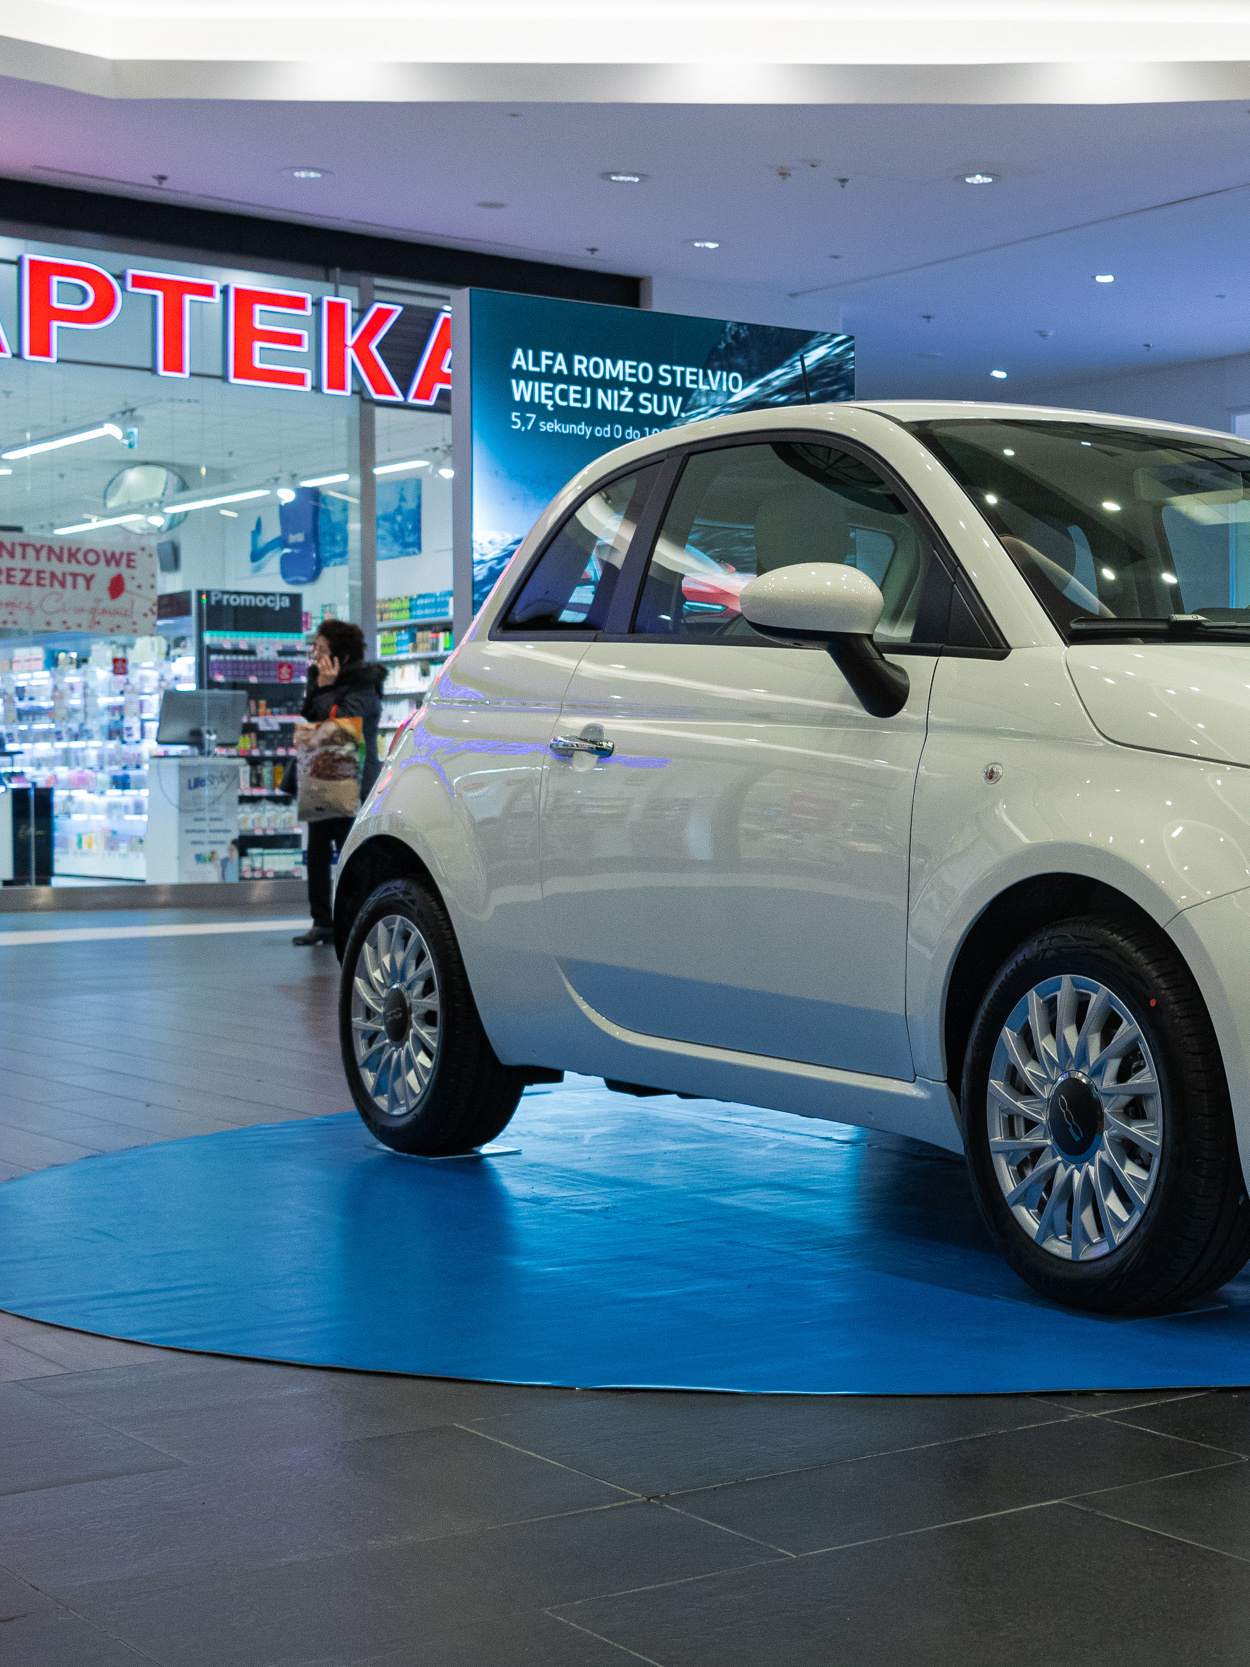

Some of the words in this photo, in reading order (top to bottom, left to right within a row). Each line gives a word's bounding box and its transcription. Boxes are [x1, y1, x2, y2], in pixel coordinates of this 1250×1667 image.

[511, 347, 568, 375] ALFA
[573, 354, 653, 384] ROMEO
[658, 364, 743, 393] STELVIO
[511, 378, 591, 411] WIĘCEJ
[597, 386, 634, 413] NIŻ
[638, 392, 686, 418] SUV.
[511, 411, 537, 432] 5,7
[539, 419, 592, 439] sekundy
[595, 423, 611, 438] od
[613, 424, 622, 439] 0
[625, 426, 641, 440] do
[0, 567, 96, 591] EZENTY
[210, 591, 290, 611] Promocja
